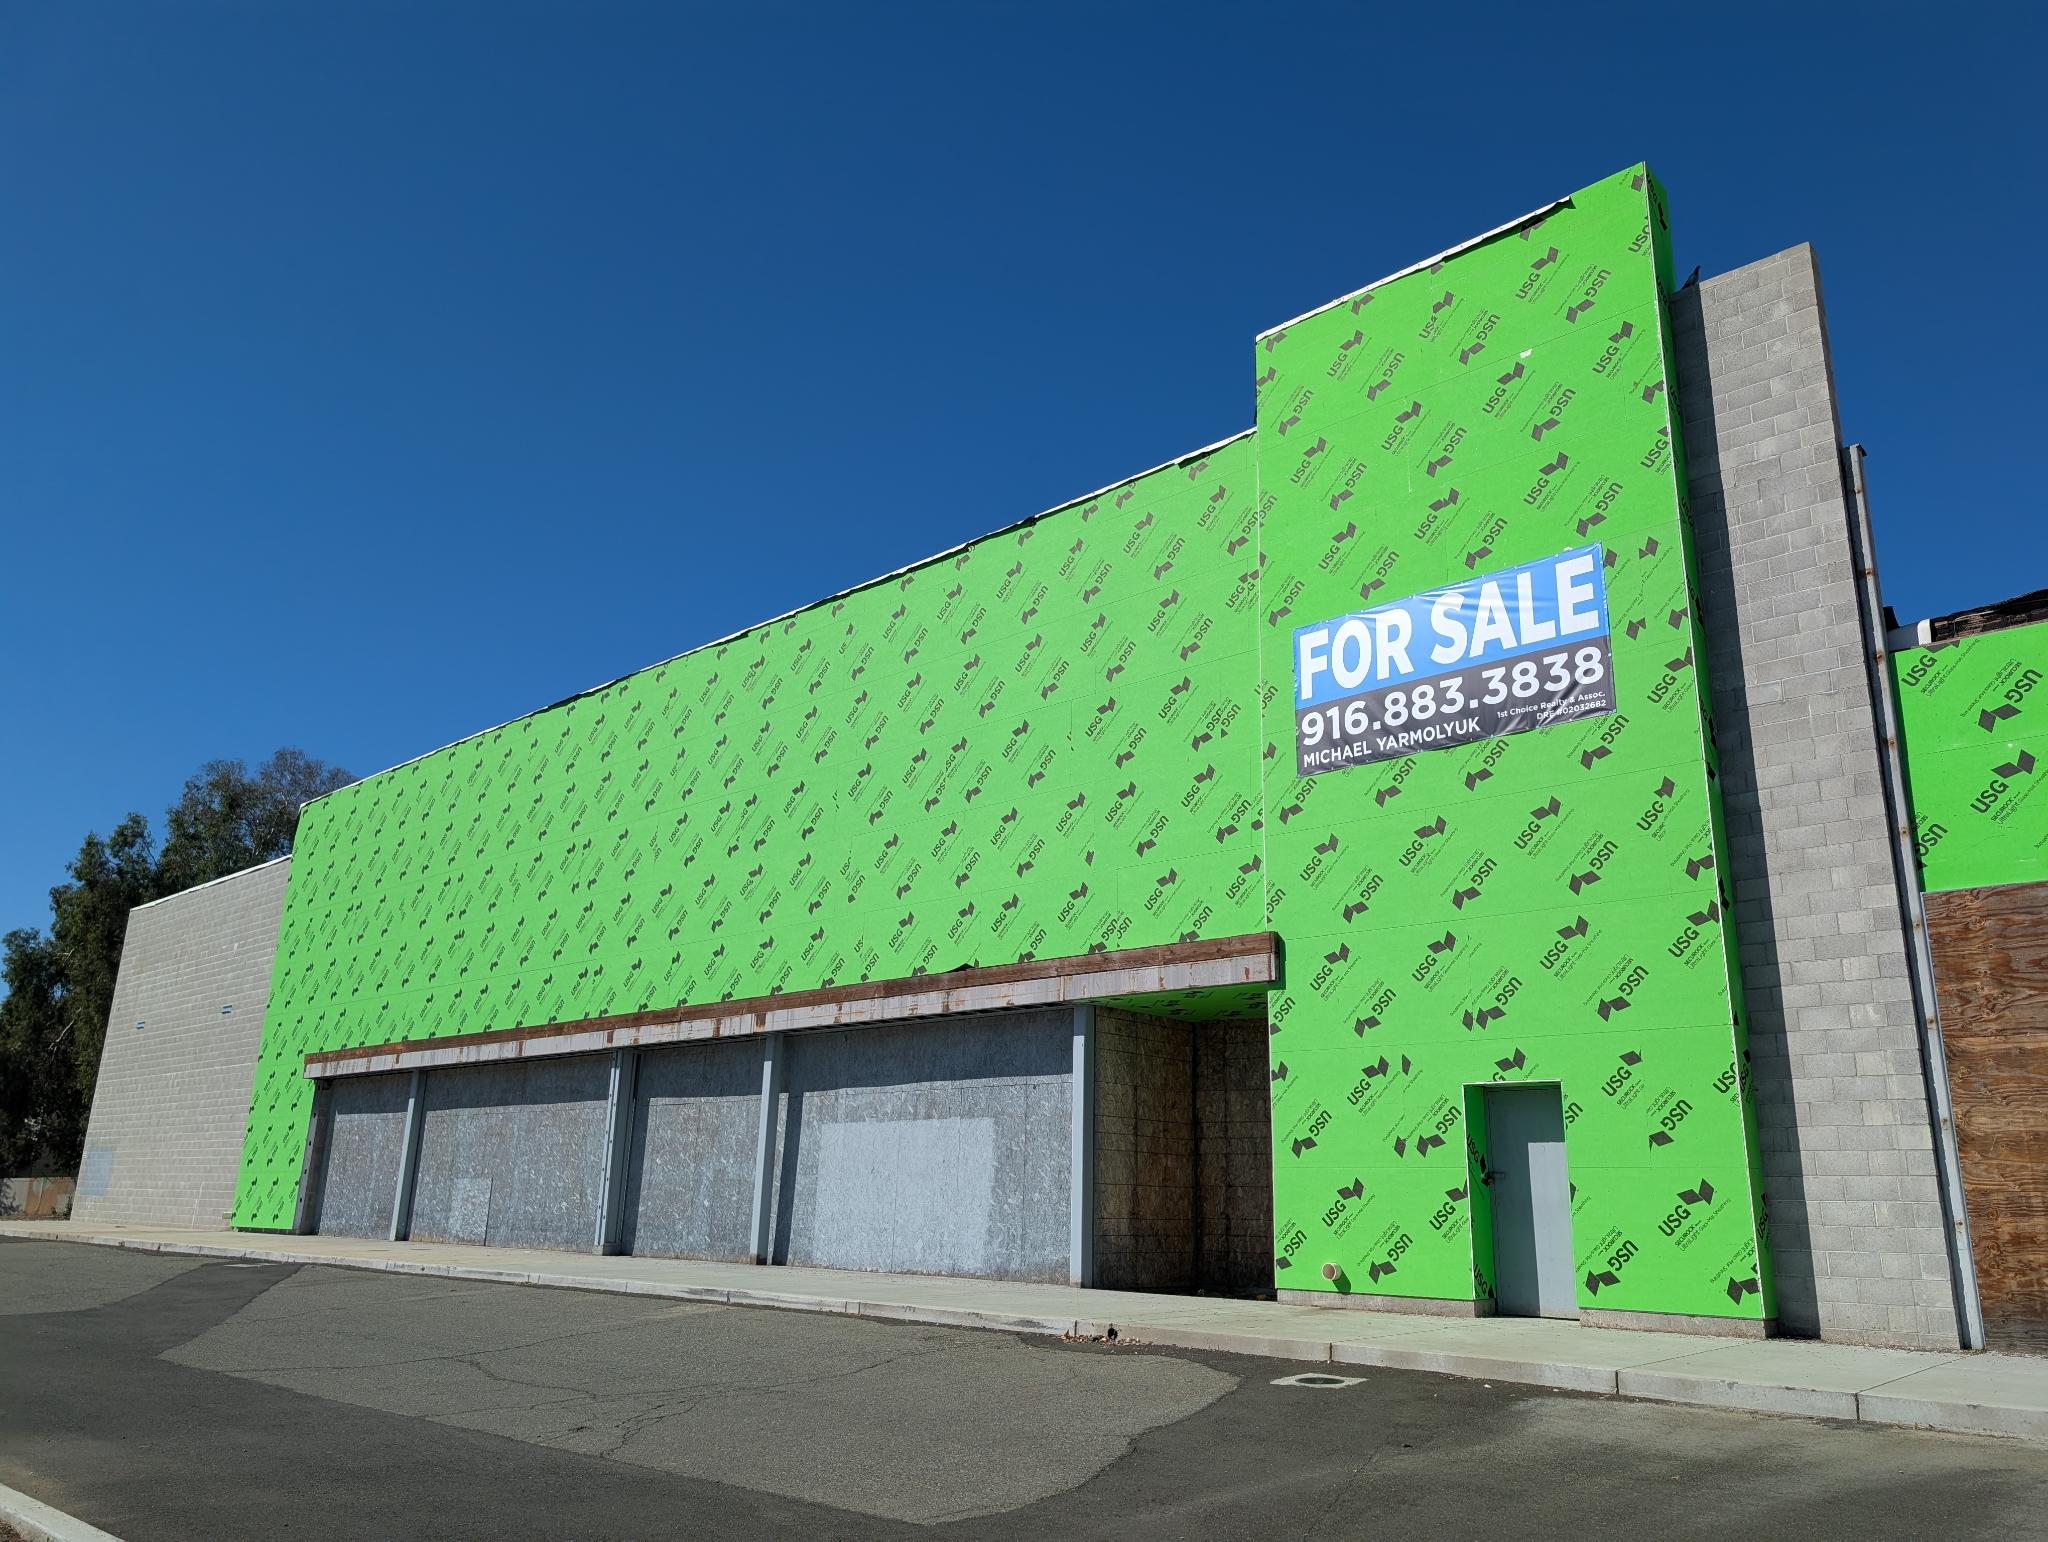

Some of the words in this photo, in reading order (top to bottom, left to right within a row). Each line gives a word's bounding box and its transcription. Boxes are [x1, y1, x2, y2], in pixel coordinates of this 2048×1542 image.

[1516, 273, 1540, 299] USG
[1584, 270, 1611, 297] USG
[1476, 314, 1500, 340] USG
[1327, 353, 1347, 377] USG
[1383, 353, 1404, 377] USG
[1592, 346, 1619, 373] USG
[1293, 390, 1313, 414] USG
[1482, 387, 1506, 413] USG
[1549, 389, 1576, 416] USG
[1382, 425, 1403, 450] USG
[1443, 428, 1467, 453] USG
[1640, 439, 1669, 468] USG
[1290, 460, 1311, 483] USG
[1345, 463, 1367, 488] USG
[1524, 478, 1550, 504] USG
[1595, 483, 1623, 511] USG
[1414, 514, 1437, 539] USG
[1482, 518, 1507, 545] USG
[1319, 545, 1340, 569] USG
[1376, 552, 1399, 577] USG
[1284, 581, 1304, 605] USG
[1300, 609, 1414, 700] FOR
[1430, 555, 1600, 664] SALE
[1901, 654, 1938, 687] USG
[1302, 647, 1604, 745] 916.883.3838
[1647, 674, 1677, 703] USG
[2004, 669, 2044, 703] USG
[1497, 710, 1507, 718] 1st
[1510, 704, 1538, 716] Choice
[1540, 698, 1567, 710] Realty
[1578, 691, 1606, 702] Assoc.
[1536, 710, 1555, 720] DRE
[1556, 699, 1607, 715] #02032682
[1304, 741, 1371, 768] MICHAEL
[1376, 716, 1481, 751] YARMOLYUK
[1600, 715, 1629, 744] USG
[1483, 740, 1509, 767] USG
[1392, 758, 1416, 784] USG
[1295, 778, 1317, 803] USG
[1969, 780, 2009, 813] USG
[1514, 821, 1541, 849] USG
[1399, 840, 1424, 866] USG
[1589, 841, 1618, 870] USG
[1300, 856, 1322, 881] USG
[1471, 858, 1497, 885] USG
[1266, 888, 1286, 913] USG
[1360, 875, 1383, 900] USG
[1540, 941, 1568, 969] USG
[1668, 927, 1699, 957] USG
[1310, 965, 1333, 991] USG
[1412, 955, 1437, 981] USG
[1618, 966, 1649, 996] USG
[1371, 989, 1396, 1015] USG
[1495, 977, 1522, 1005] USG
[1274, 997, 1295, 1022] USG
[1347, 1079, 1371, 1105] USG
[1601, 1067, 1632, 1096] USG
[1309, 1110, 1332, 1136] USG
[1435, 1106, 1461, 1134] USG
[1564, 1102, 1583, 1131] US
[1660, 1100, 1693, 1130] USG
[1322, 1200, 1346, 1227] USG
[1429, 1202, 1456, 1230] USG
[1658, 1205, 1691, 1236] USG
[1284, 1230, 1307, 1256] USG
[1387, 1234, 1413, 1261] USG
[1607, 1240, 1639, 1271] USG
